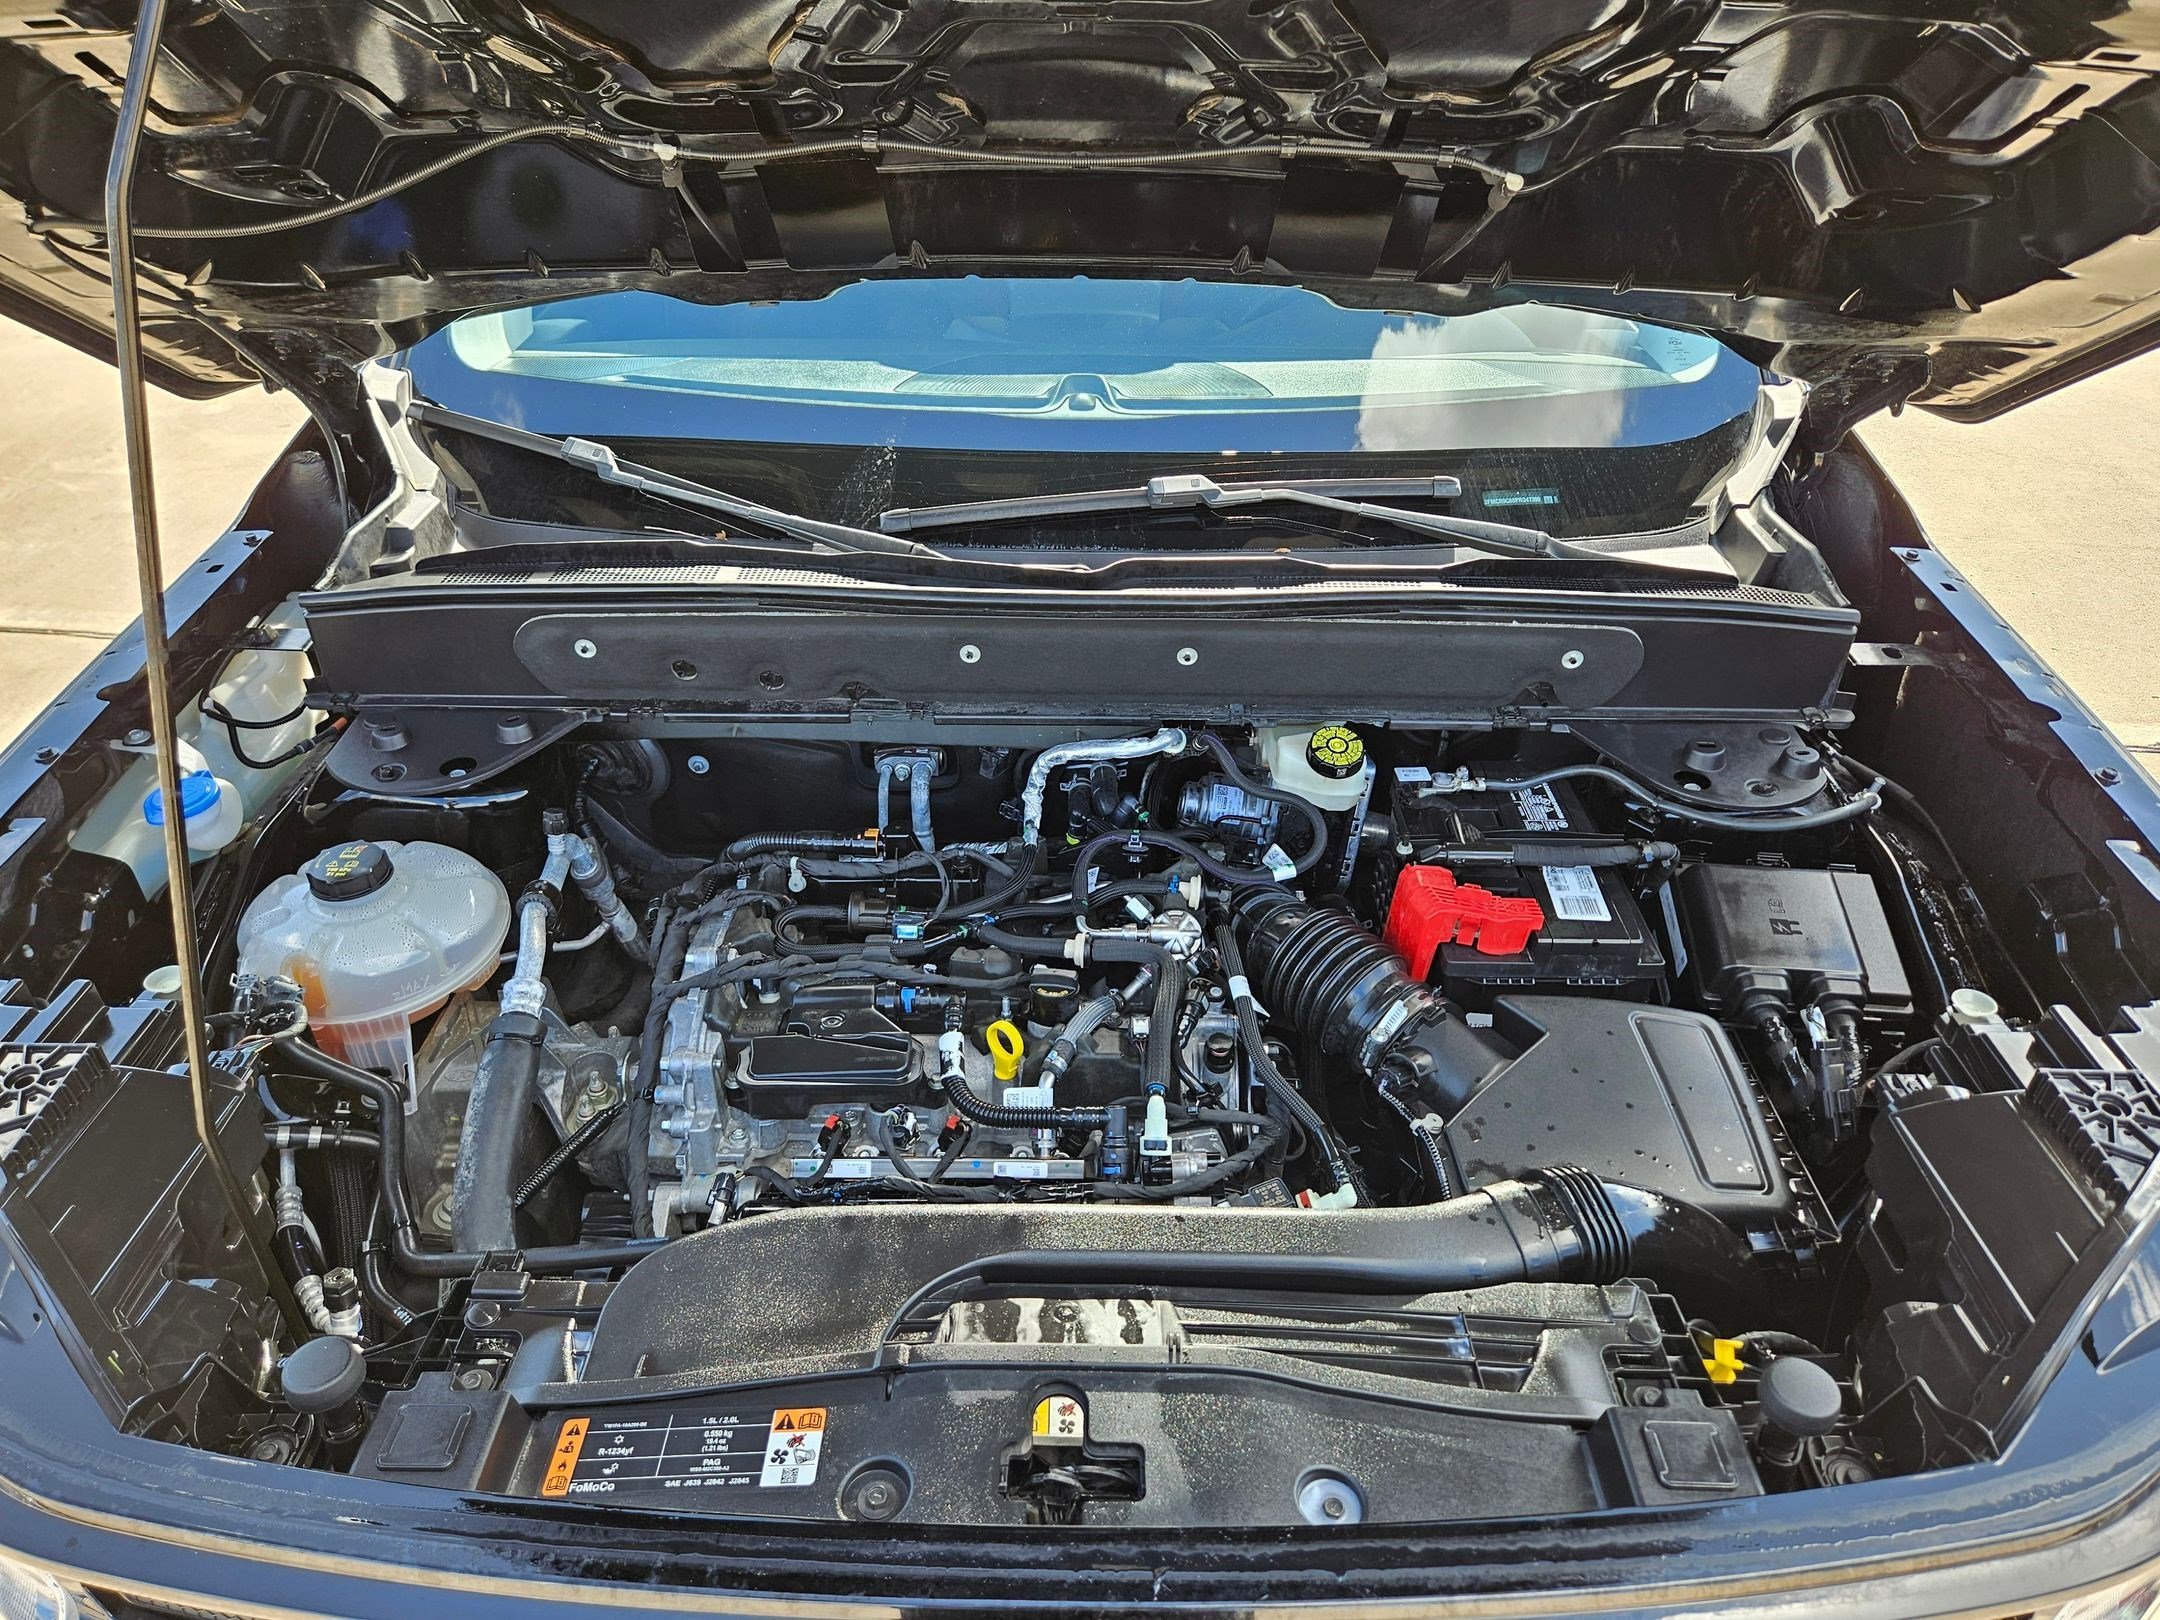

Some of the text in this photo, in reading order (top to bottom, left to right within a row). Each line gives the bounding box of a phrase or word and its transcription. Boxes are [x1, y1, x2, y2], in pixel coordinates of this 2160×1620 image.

[400, 974, 432, 996] MAX
[723, 1415, 739, 1424] 2.0L
[723, 1430, 733, 1439] kg
[598, 1446, 635, 1456] R-1234yf
[702, 1459, 721, 1467] PAG
[569, 1481, 615, 1492] FoMoCo
[664, 1480, 681, 1488] SAE
